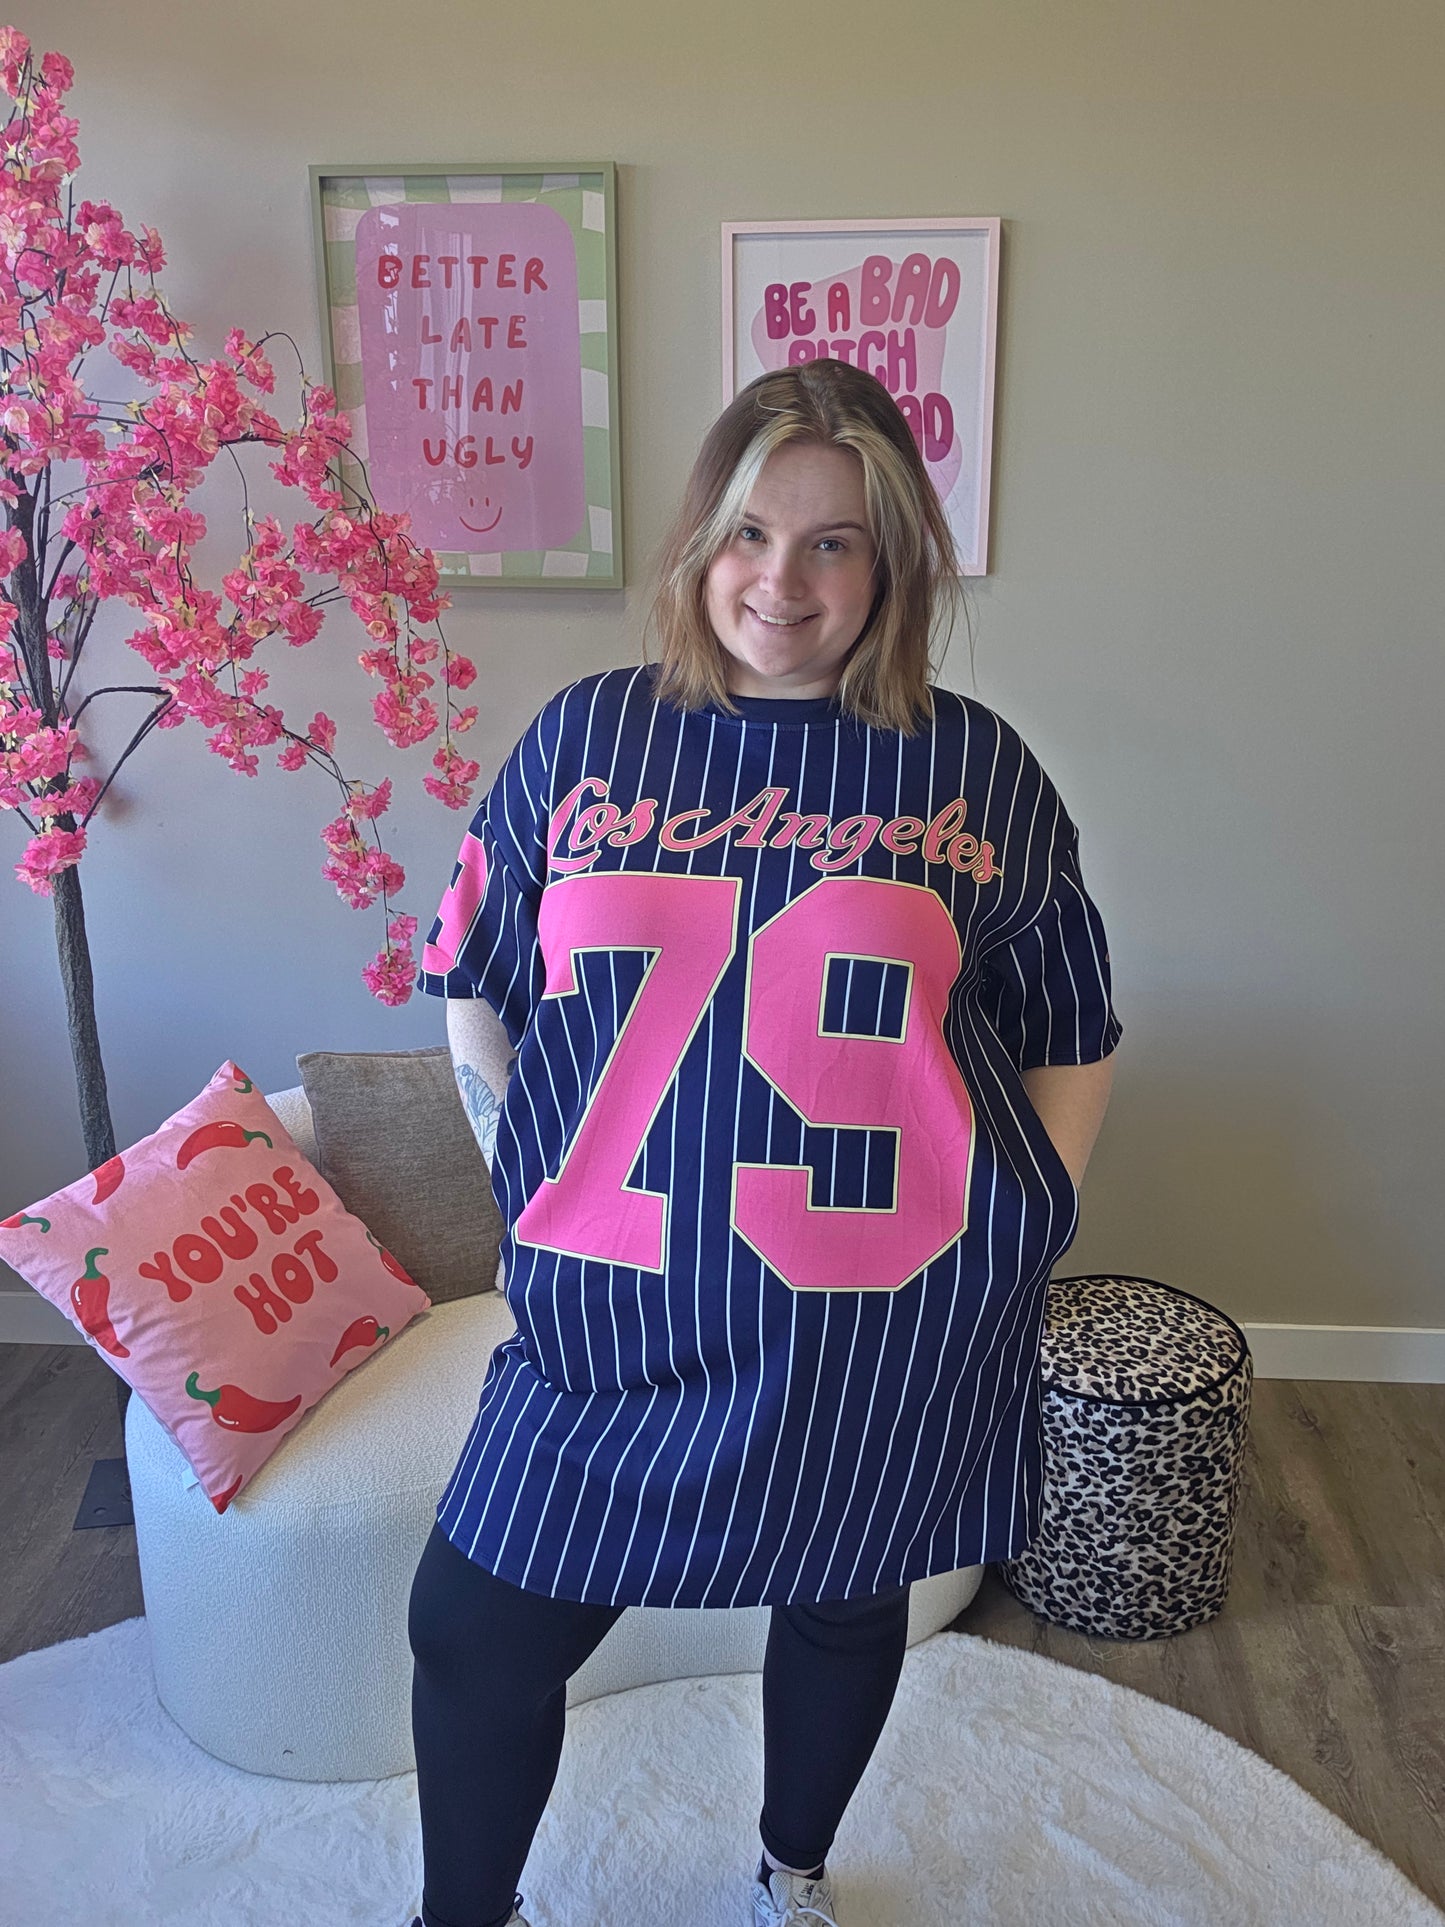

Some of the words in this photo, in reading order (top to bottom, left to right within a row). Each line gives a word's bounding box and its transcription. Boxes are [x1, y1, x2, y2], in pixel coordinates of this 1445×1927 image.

[377, 254, 548, 294] BETTER
[764, 282, 816, 339] BE
[827, 282, 850, 333] A
[859, 253, 961, 329] BAD
[421, 315, 528, 353] LATE
[412, 375, 524, 415] THAN
[422, 436, 534, 470] UGLY
[547, 777, 658, 873] Los
[659, 787, 1003, 883] Angeles
[511, 871, 977, 1293] 79
[138, 1166, 320, 1303] YOU'RE
[234, 1229, 339, 1335] HOT
